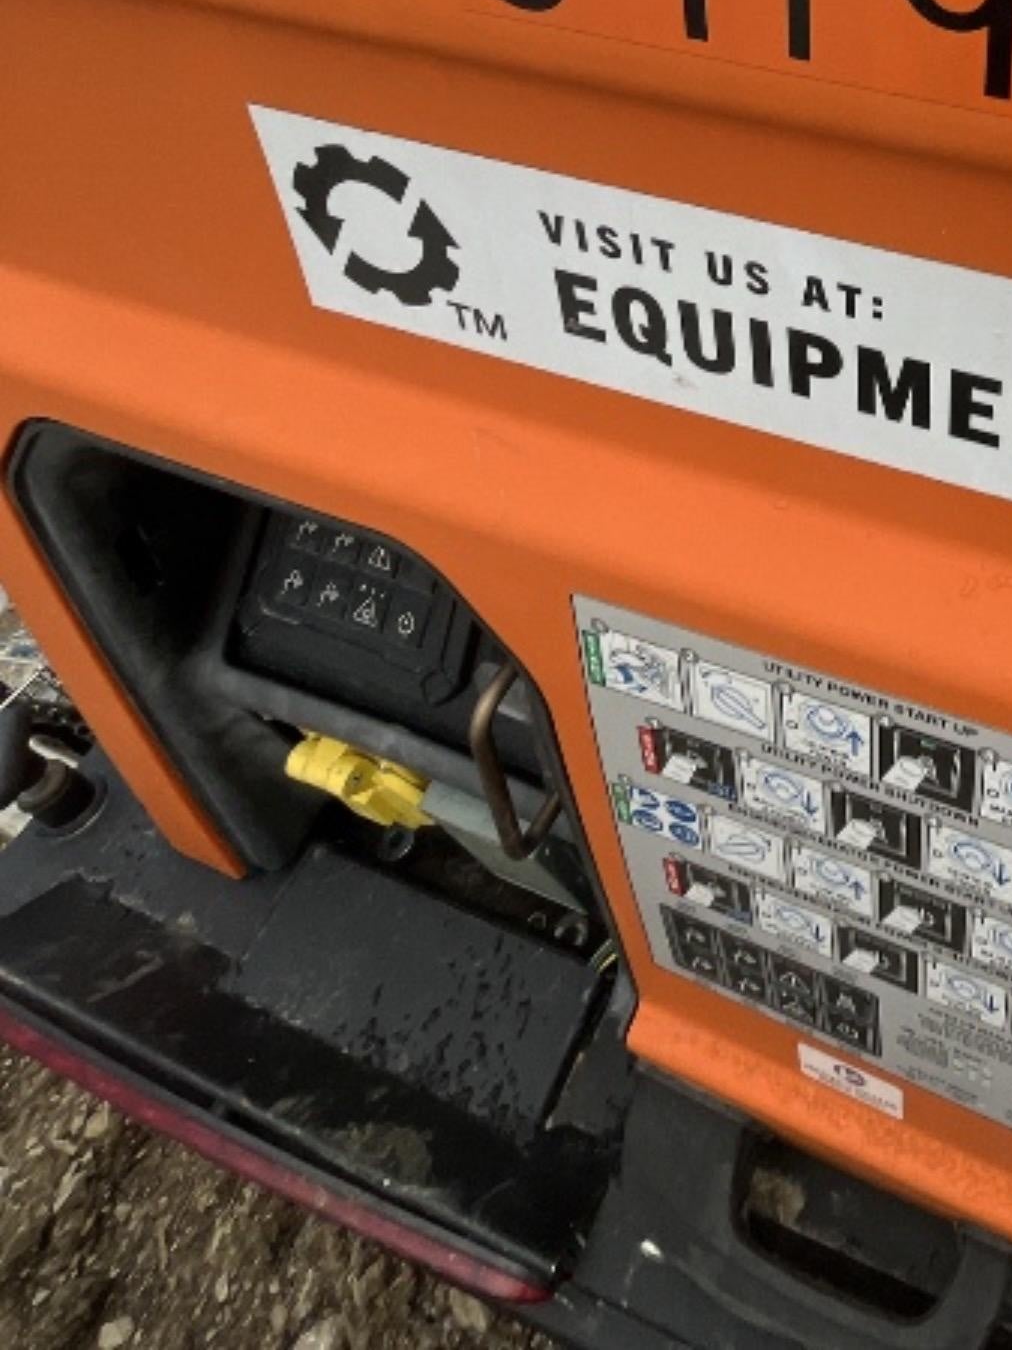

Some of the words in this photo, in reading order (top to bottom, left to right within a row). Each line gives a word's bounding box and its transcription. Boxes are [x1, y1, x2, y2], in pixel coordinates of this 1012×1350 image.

[538, 210, 675, 272] VISIT
[705, 251, 769, 295] US
[801, 276, 883, 319] AT:
[447, 300, 508, 341] TM
[763, 660, 822, 688] UTILITY
[827, 681, 888, 709] POWER
[894, 703, 949, 730] START
[953, 723, 979, 737] UP
